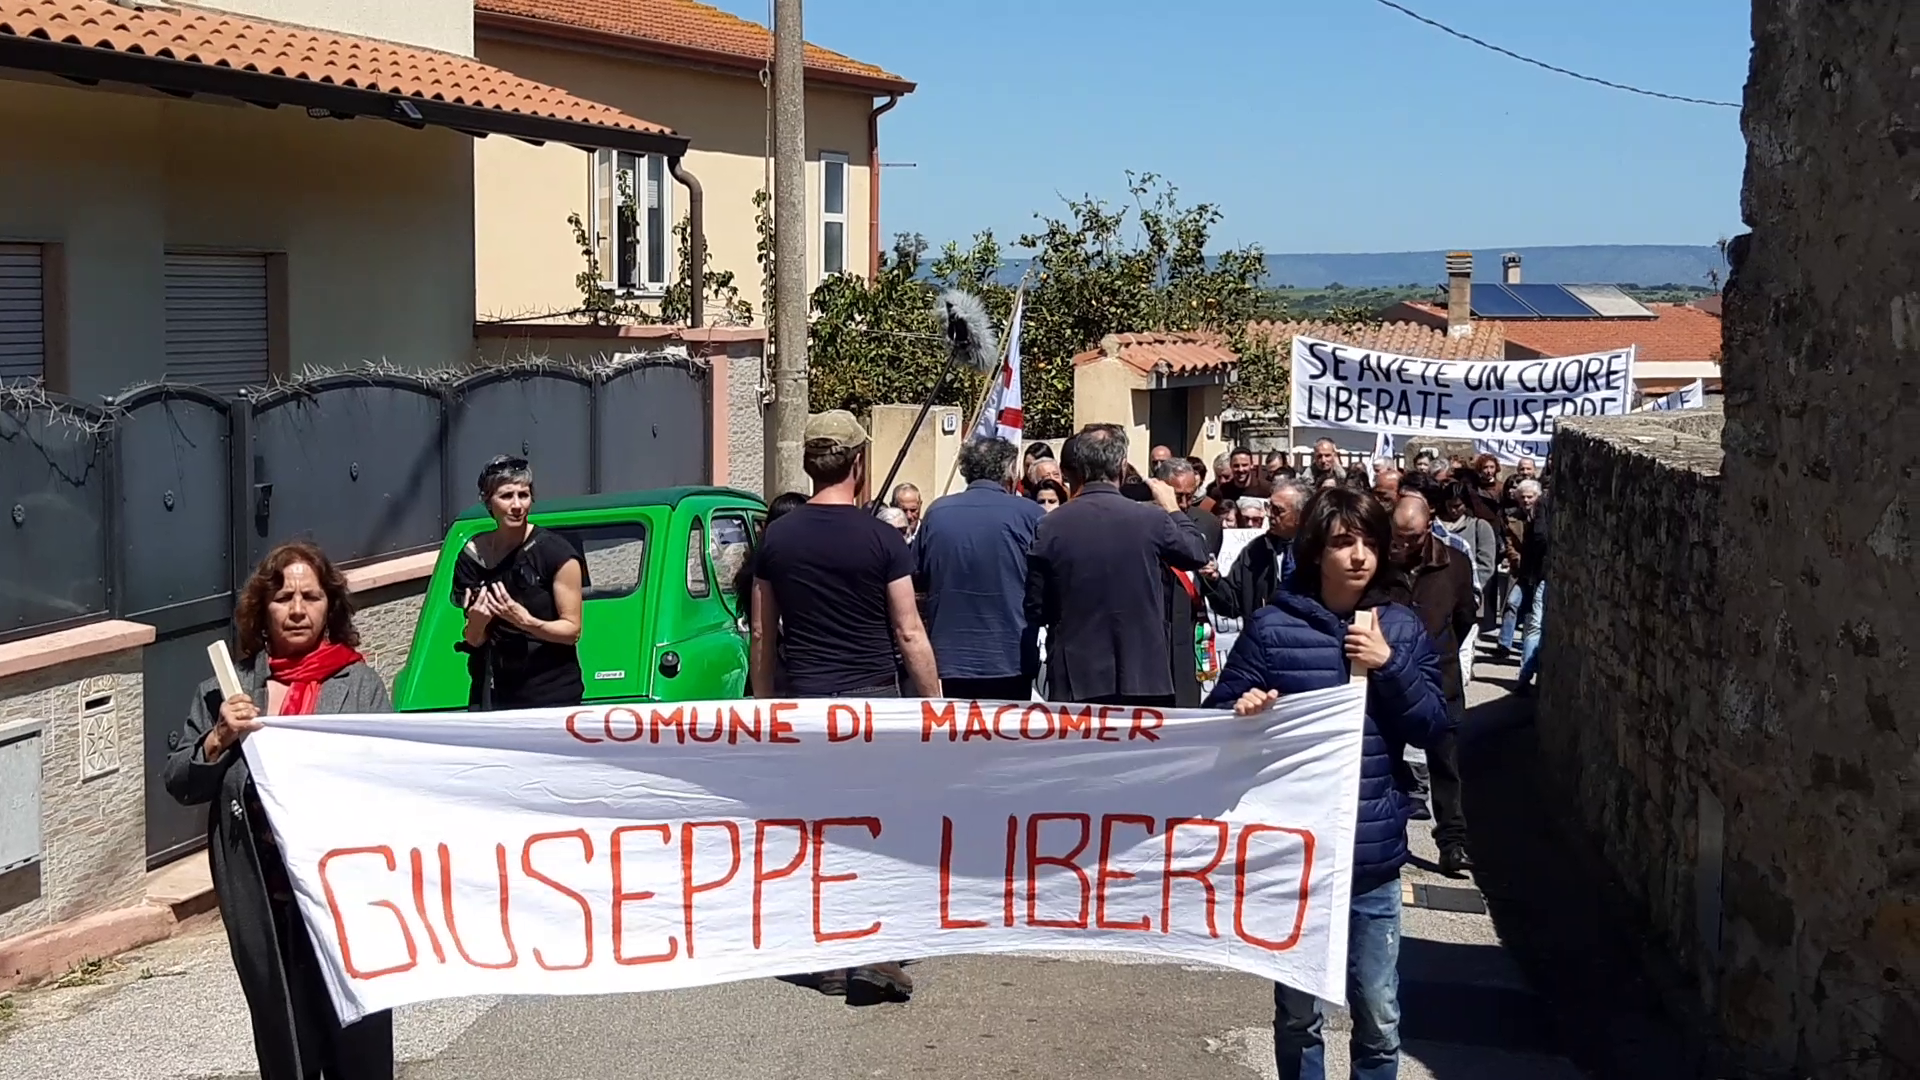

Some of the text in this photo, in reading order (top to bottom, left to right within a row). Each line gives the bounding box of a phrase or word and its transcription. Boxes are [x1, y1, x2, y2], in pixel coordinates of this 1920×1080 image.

[1308, 342, 1624, 393] SE AVETE UN CUORE
[1306, 385, 1454, 429] LIBERATE
[566, 702, 1166, 744] COMUNE DI MACOMER
[318, 814, 1318, 980] GIUSEPPE LIBERO
